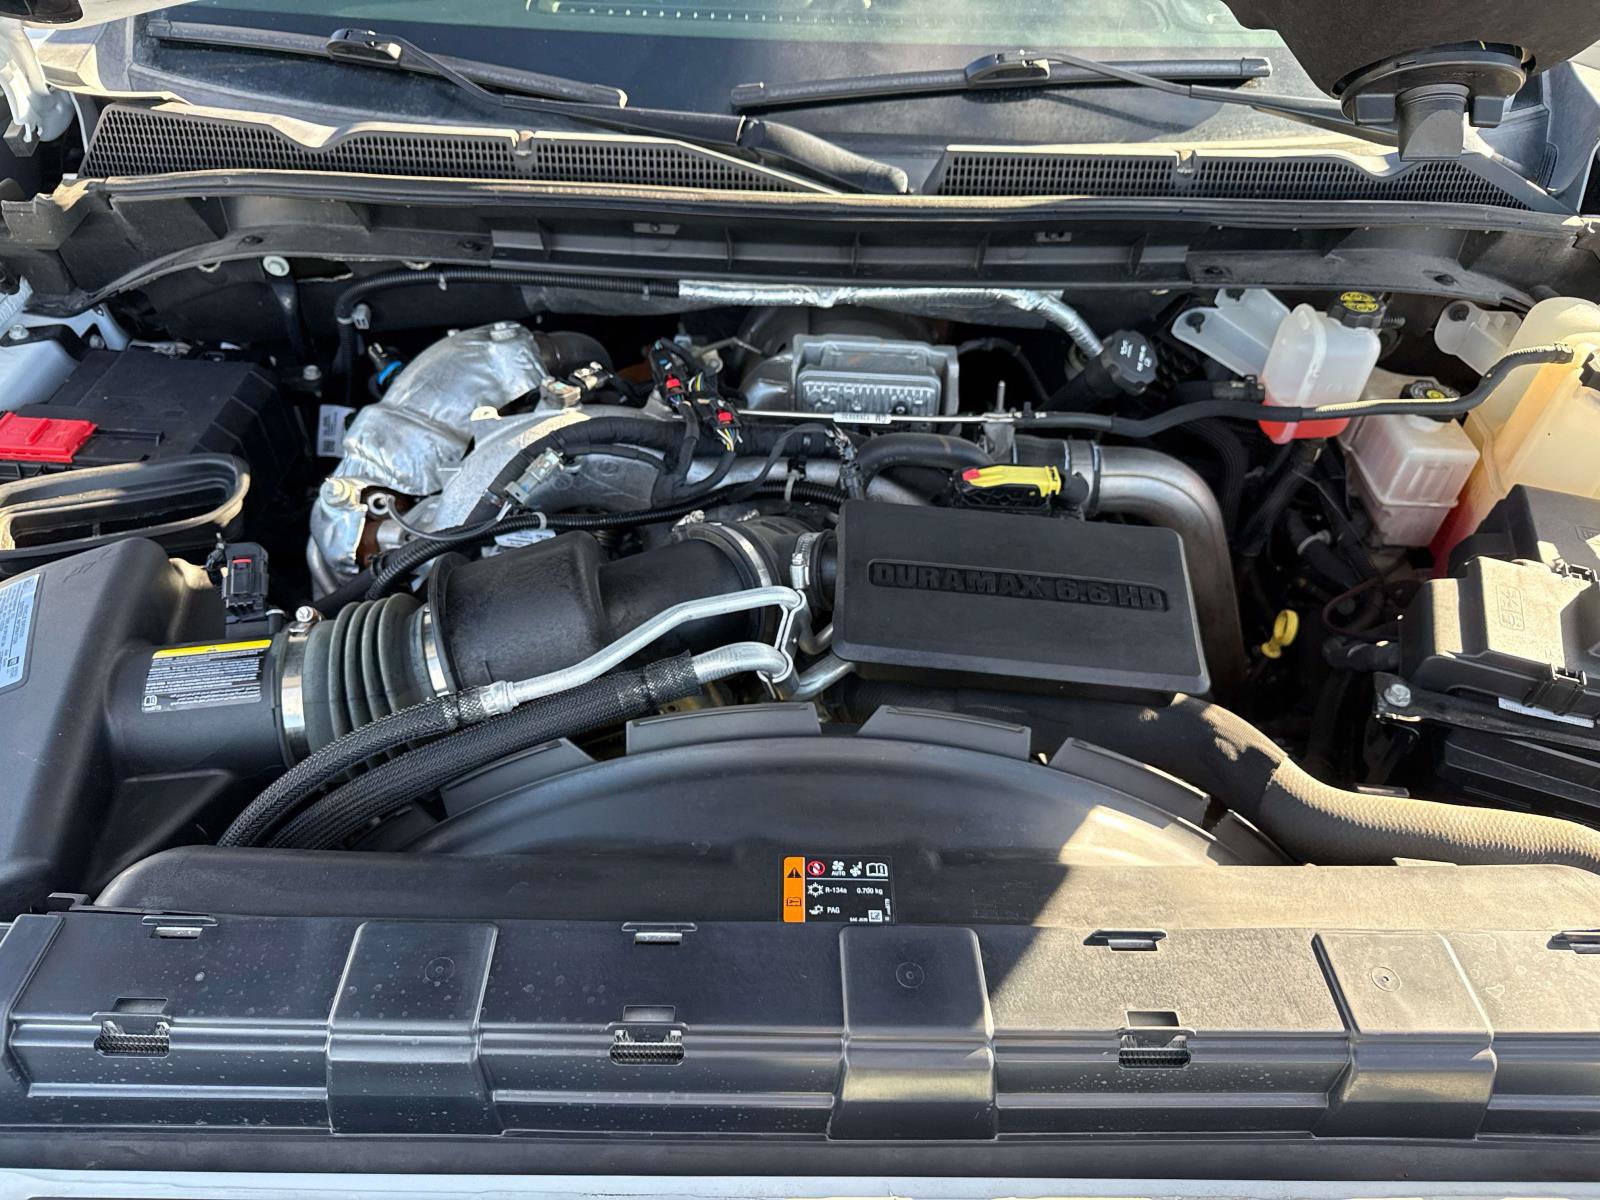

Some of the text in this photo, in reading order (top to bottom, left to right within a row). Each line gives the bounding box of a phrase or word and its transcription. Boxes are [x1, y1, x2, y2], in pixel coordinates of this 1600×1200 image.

[872, 562, 1165, 612] DURAMAX 6.6 HD
